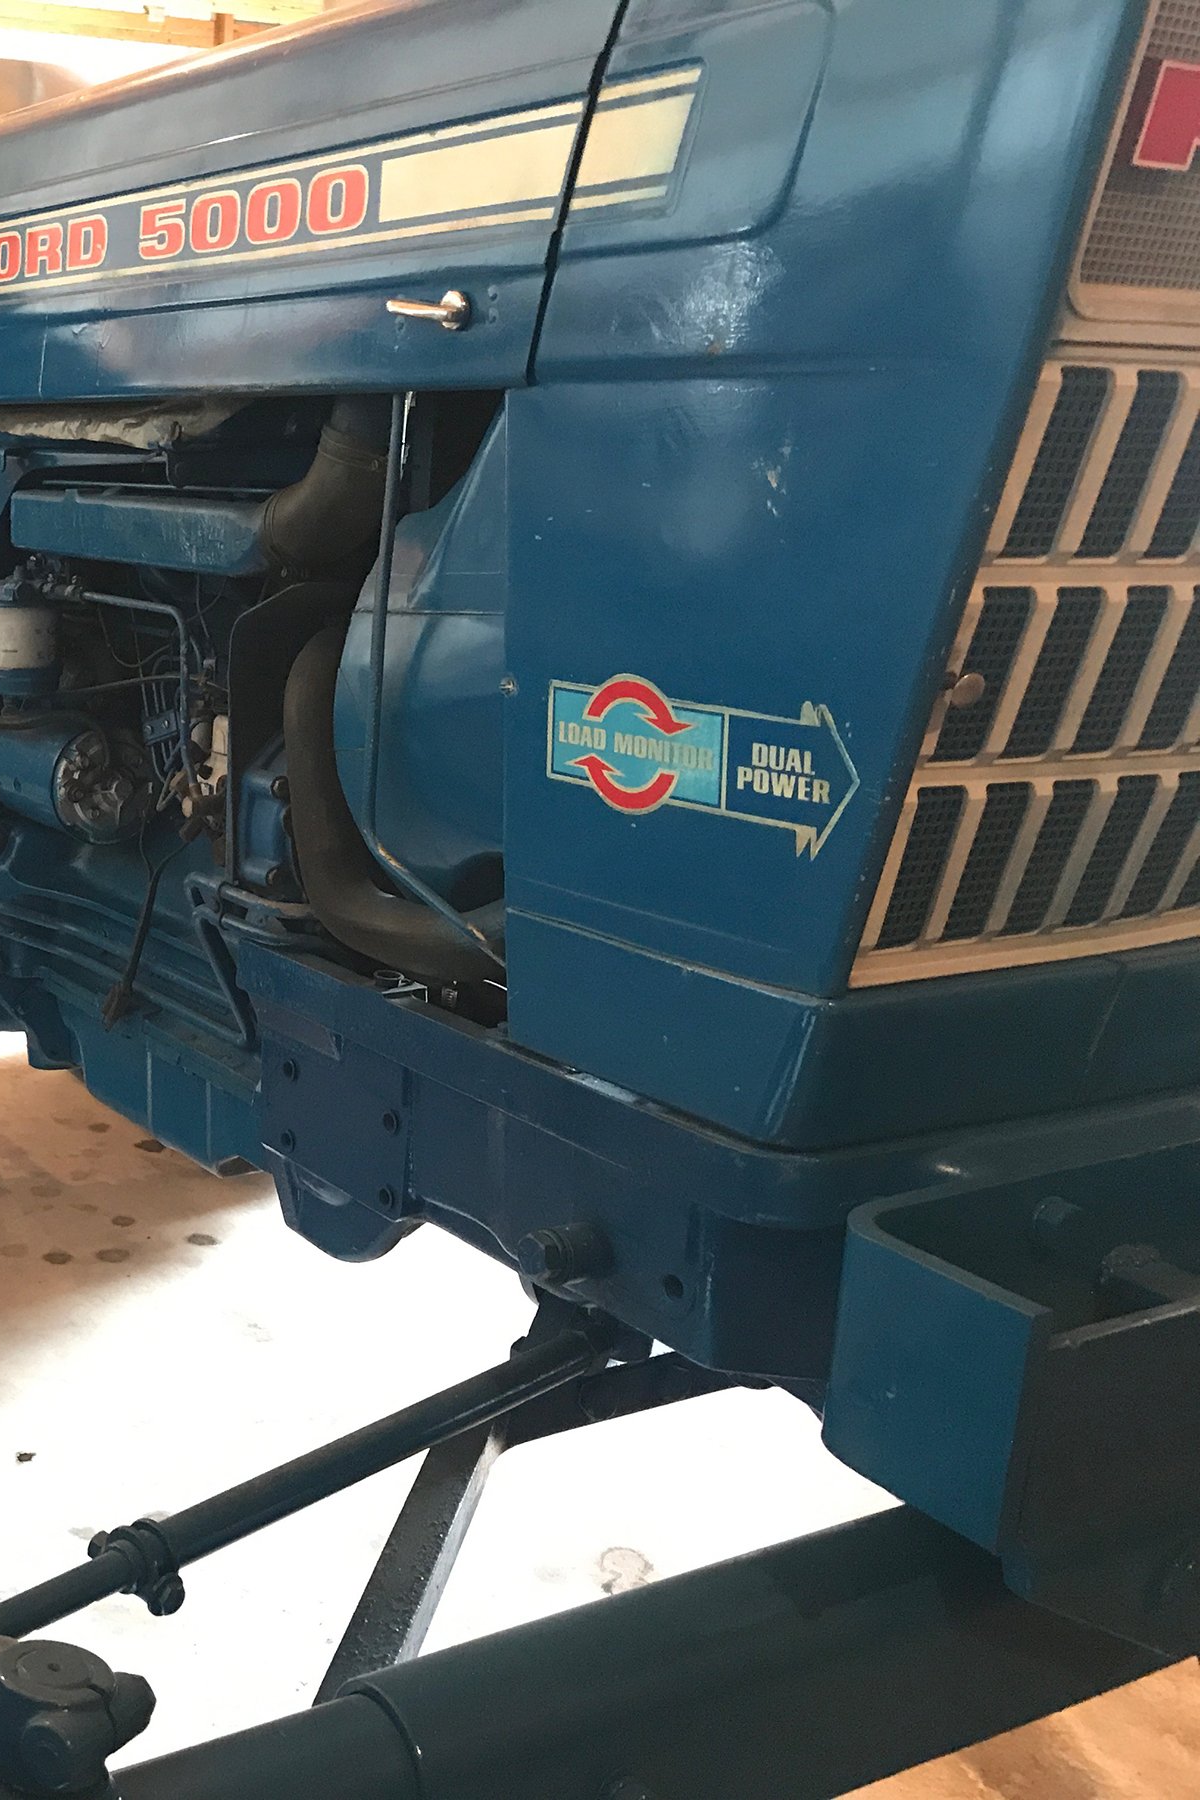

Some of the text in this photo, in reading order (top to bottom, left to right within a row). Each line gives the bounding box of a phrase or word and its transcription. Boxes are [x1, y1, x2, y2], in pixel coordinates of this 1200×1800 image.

[138, 164, 369, 260] 5000
[558, 720, 714, 770] LOAD MONITOR
[751, 742, 816, 775] DUAL
[736, 766, 831, 804] POWER
